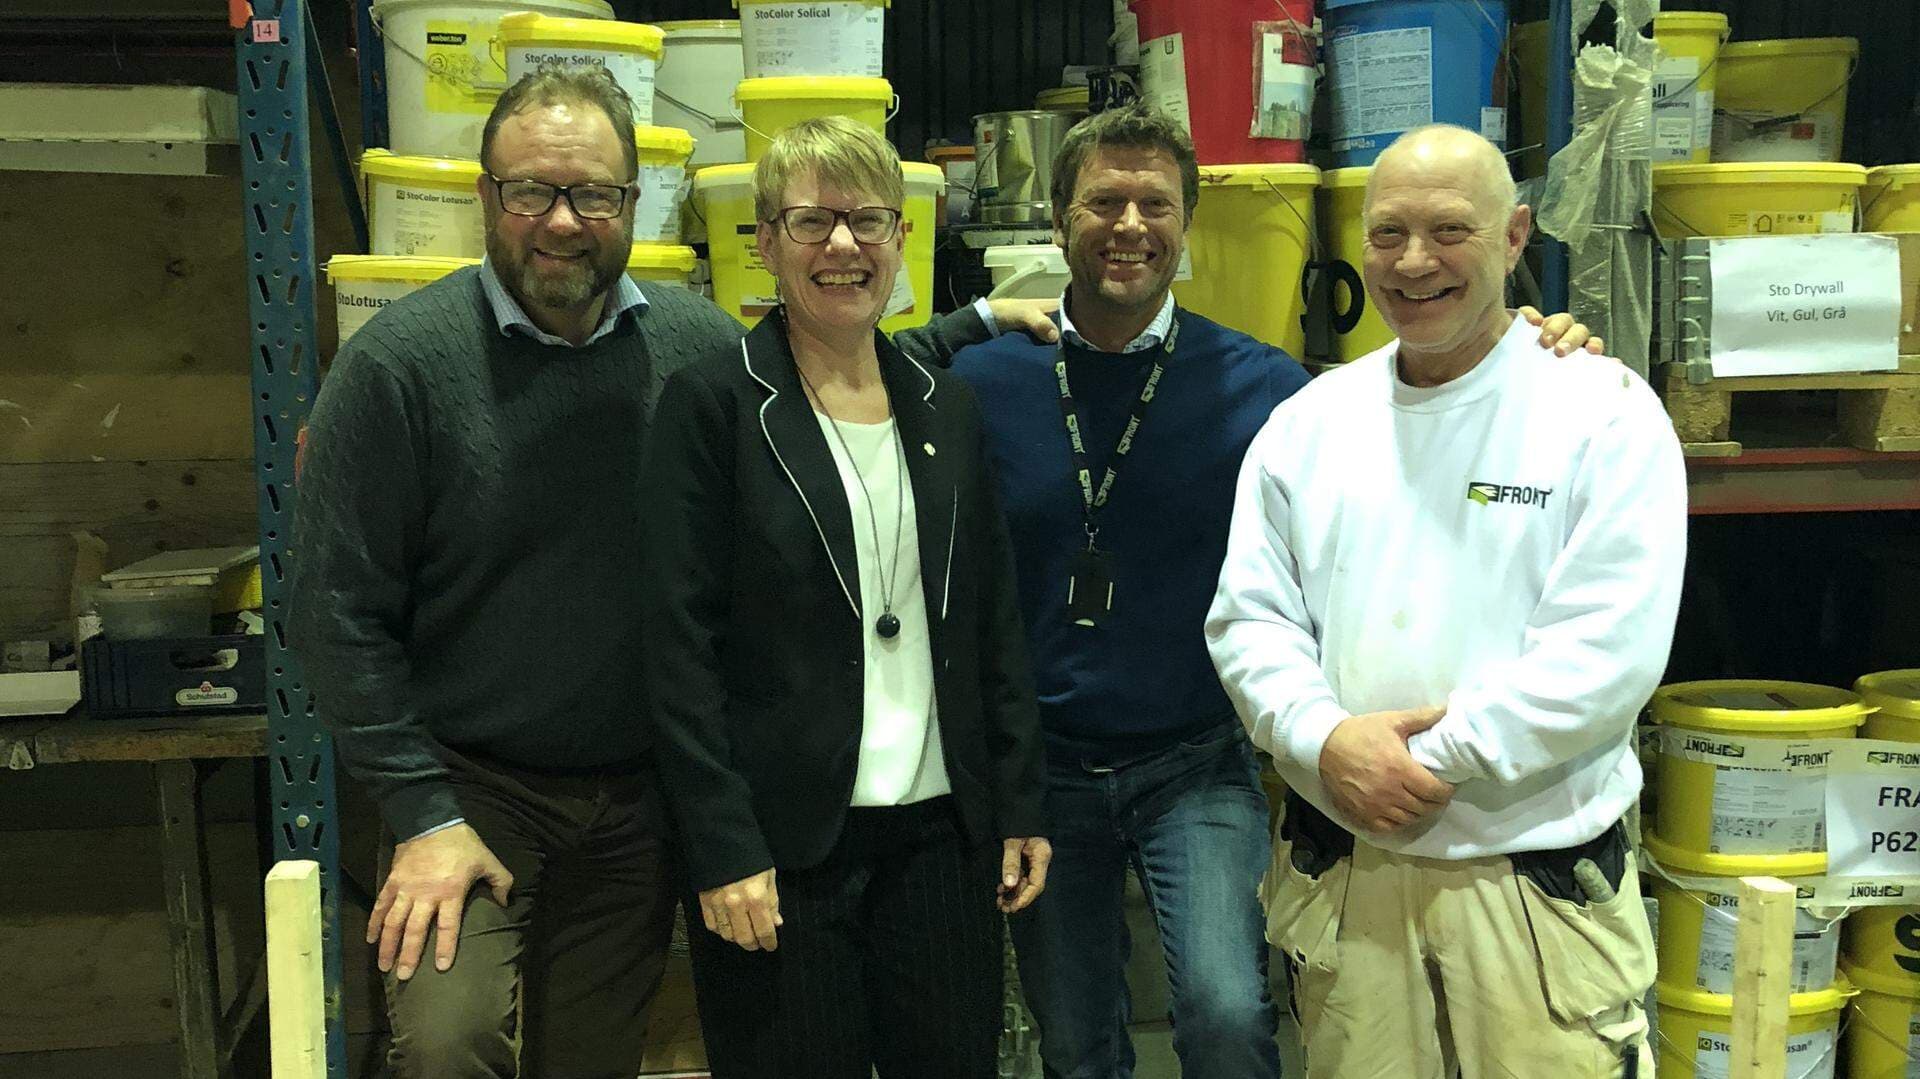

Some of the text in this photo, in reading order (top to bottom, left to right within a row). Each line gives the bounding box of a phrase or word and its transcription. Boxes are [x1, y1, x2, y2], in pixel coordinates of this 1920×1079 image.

[755, 8, 831, 19] StoColor Solical
[256, 24, 272, 37] 14
[525, 53, 606, 66] StoColor Solical
[406, 192, 440, 202] StoColor
[1768, 281, 1844, 297] Sto Drywall
[1767, 306, 1846, 323] Vit, Gul, Grå
[1500, 486, 1552, 509] FRONT
[1683, 738, 1723, 756] FRONT
[1797, 750, 1833, 767] FRONT
[1848, 886, 1885, 899] FRONT
